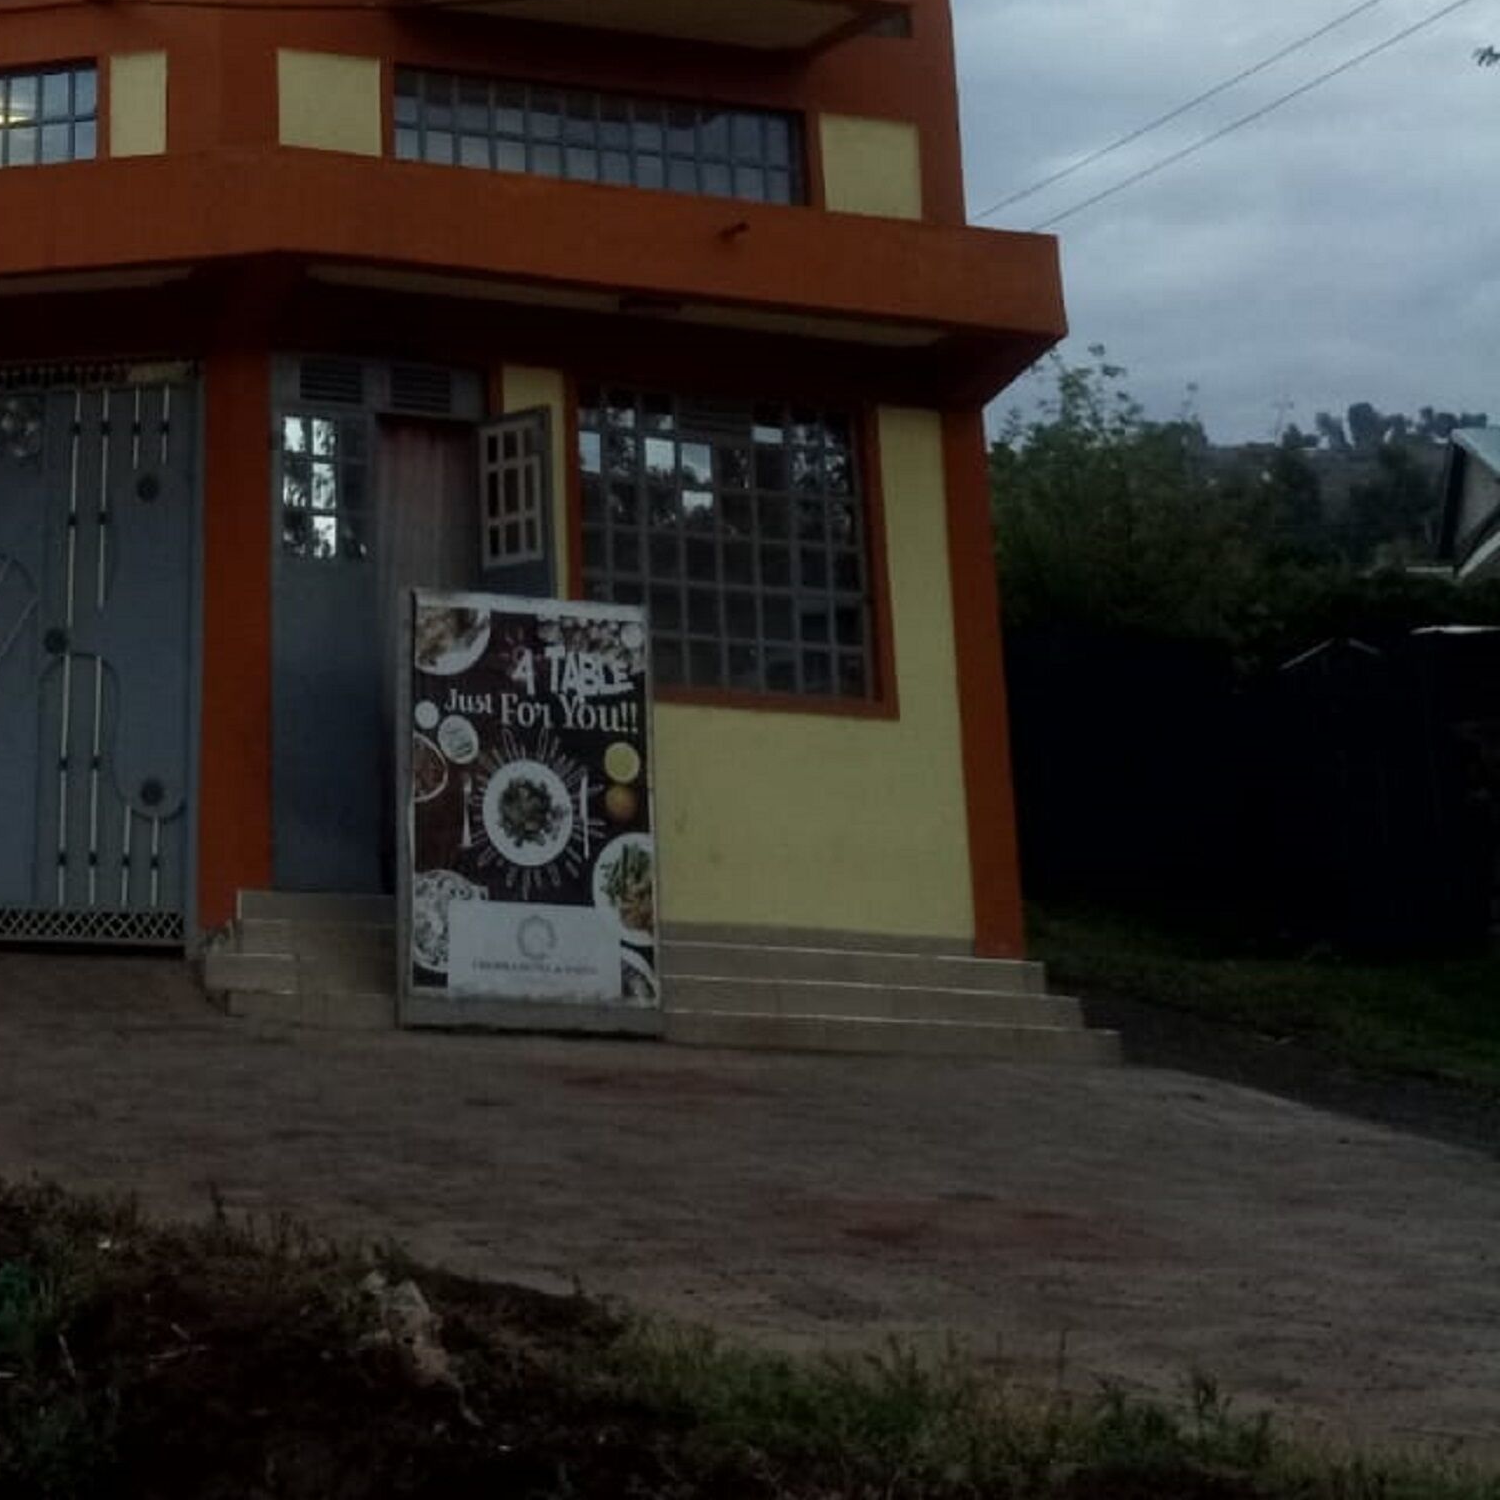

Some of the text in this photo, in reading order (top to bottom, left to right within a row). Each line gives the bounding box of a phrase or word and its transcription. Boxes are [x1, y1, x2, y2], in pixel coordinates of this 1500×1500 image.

[545, 644, 635, 696] TABLE
[444, 688, 639, 732] Just For You!!
